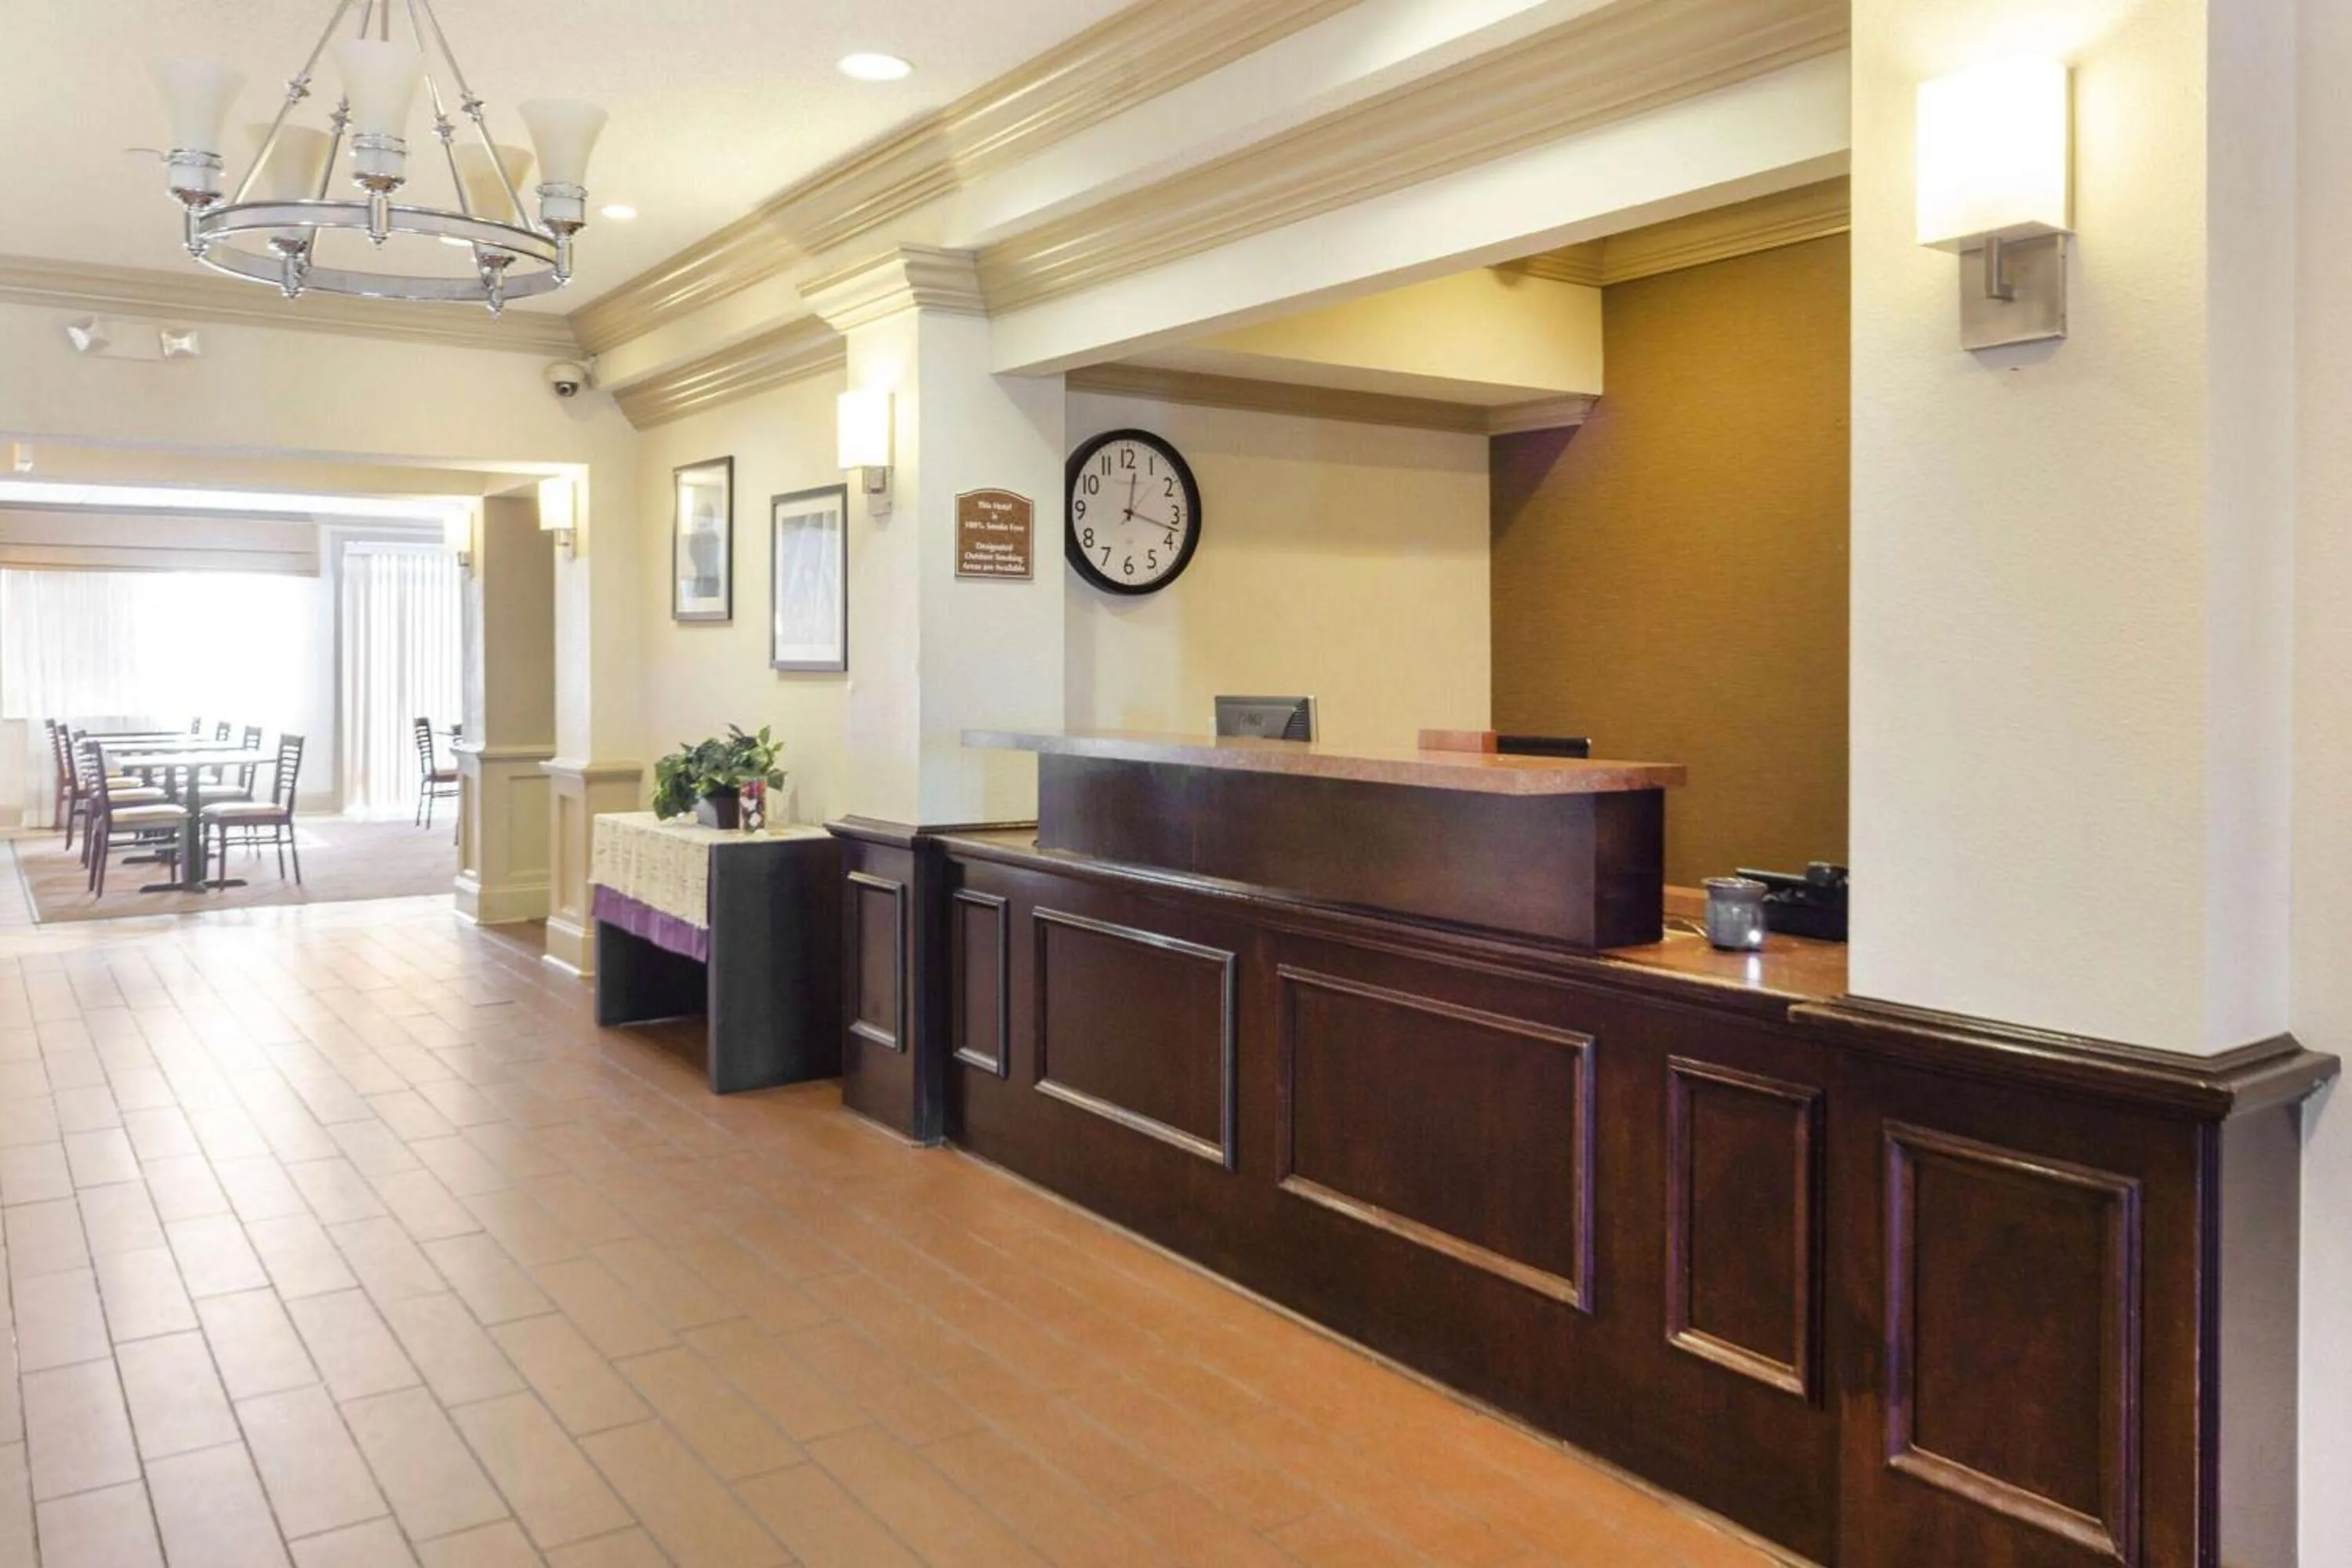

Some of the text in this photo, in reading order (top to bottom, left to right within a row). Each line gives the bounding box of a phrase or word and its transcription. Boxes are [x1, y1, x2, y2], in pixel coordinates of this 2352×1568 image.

[1102, 455, 1111, 476] 11
[1120, 448, 1136, 469] 12
[1149, 456, 1153, 476] 1
[1083, 474, 1099, 495] 10
[1163, 477, 1174, 497] 2
[1075, 499, 1086, 521] 9
[1171, 505, 1180, 524] 3
[1083, 528, 1094, 548] 8
[1163, 532, 1174, 550] 4
[1101, 546, 1111, 566] 7
[1123, 555, 1134, 575] 6
[1147, 550, 1156, 569] 5
